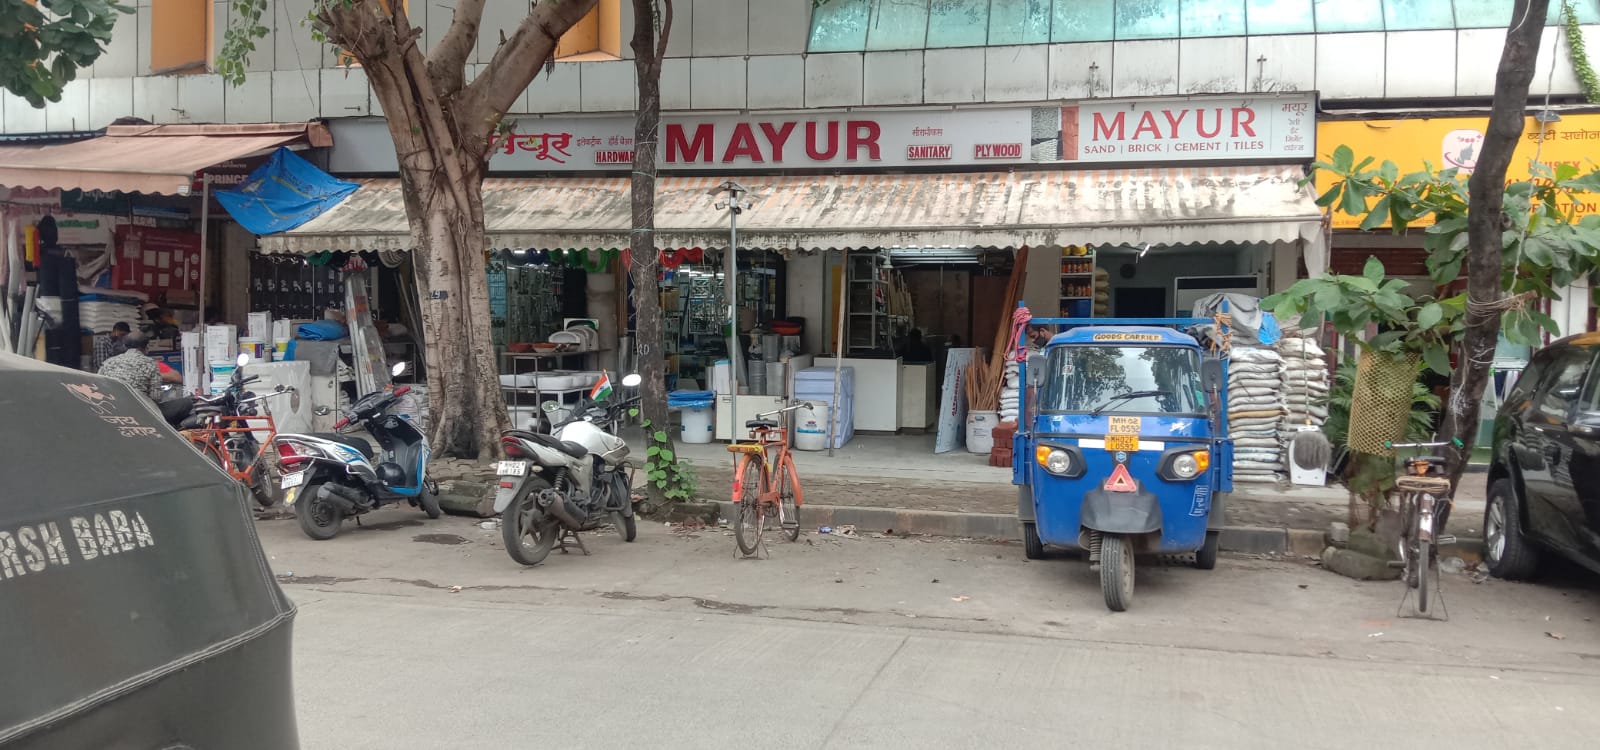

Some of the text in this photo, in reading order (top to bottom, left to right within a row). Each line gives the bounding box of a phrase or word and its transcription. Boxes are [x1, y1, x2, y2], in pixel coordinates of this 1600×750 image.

[1281, 103, 1309, 116] मयूर
[1092, 107, 1257, 141] MAYUR
[666, 120, 881, 163] MAYUR
[1084, 141, 1264, 154] SAND BRICK CEMENT TILES
[596, 151, 635, 162] HARDWAR
[909, 146, 951, 158] SANITARY
[0, 510, 155, 580] RSH BABA
